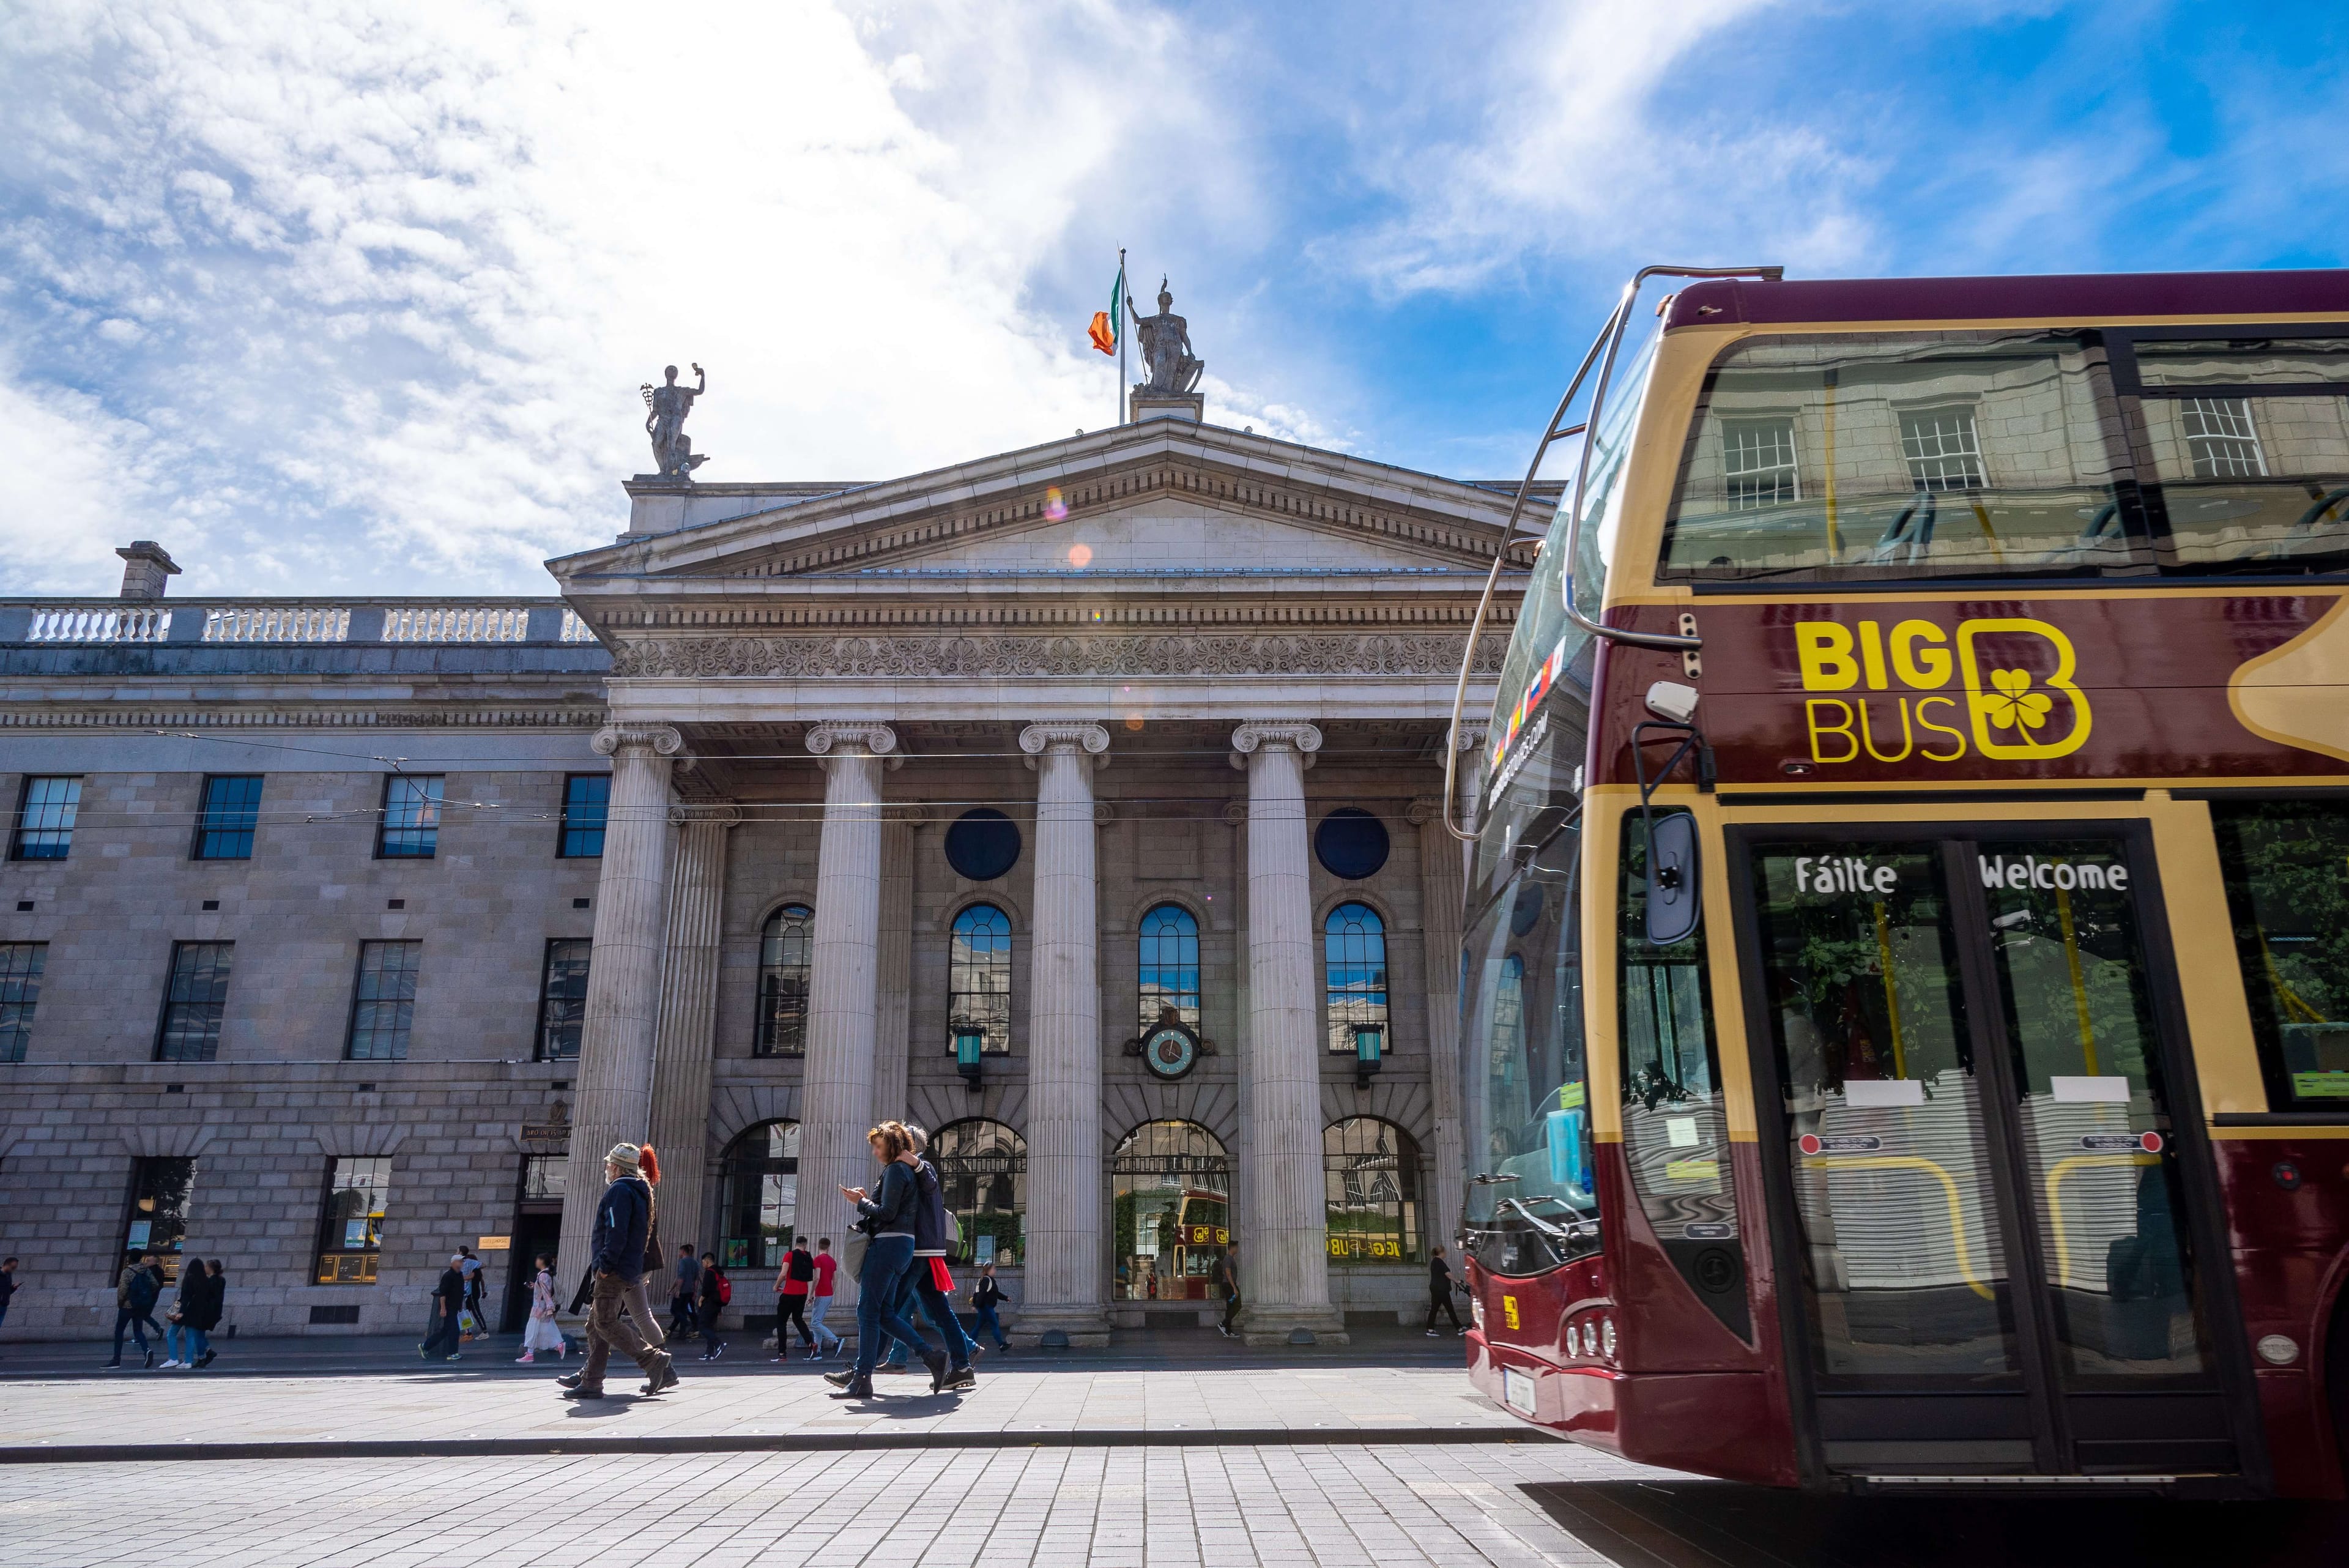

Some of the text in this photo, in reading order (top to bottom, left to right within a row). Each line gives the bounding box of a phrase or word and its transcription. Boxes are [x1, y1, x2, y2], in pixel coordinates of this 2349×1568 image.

[1795, 620, 1953, 691] BIG
[1805, 696, 1967, 763] BUS
[1796, 855, 1897, 893] Fáilte
[1978, 855, 2128, 891] Welcome
